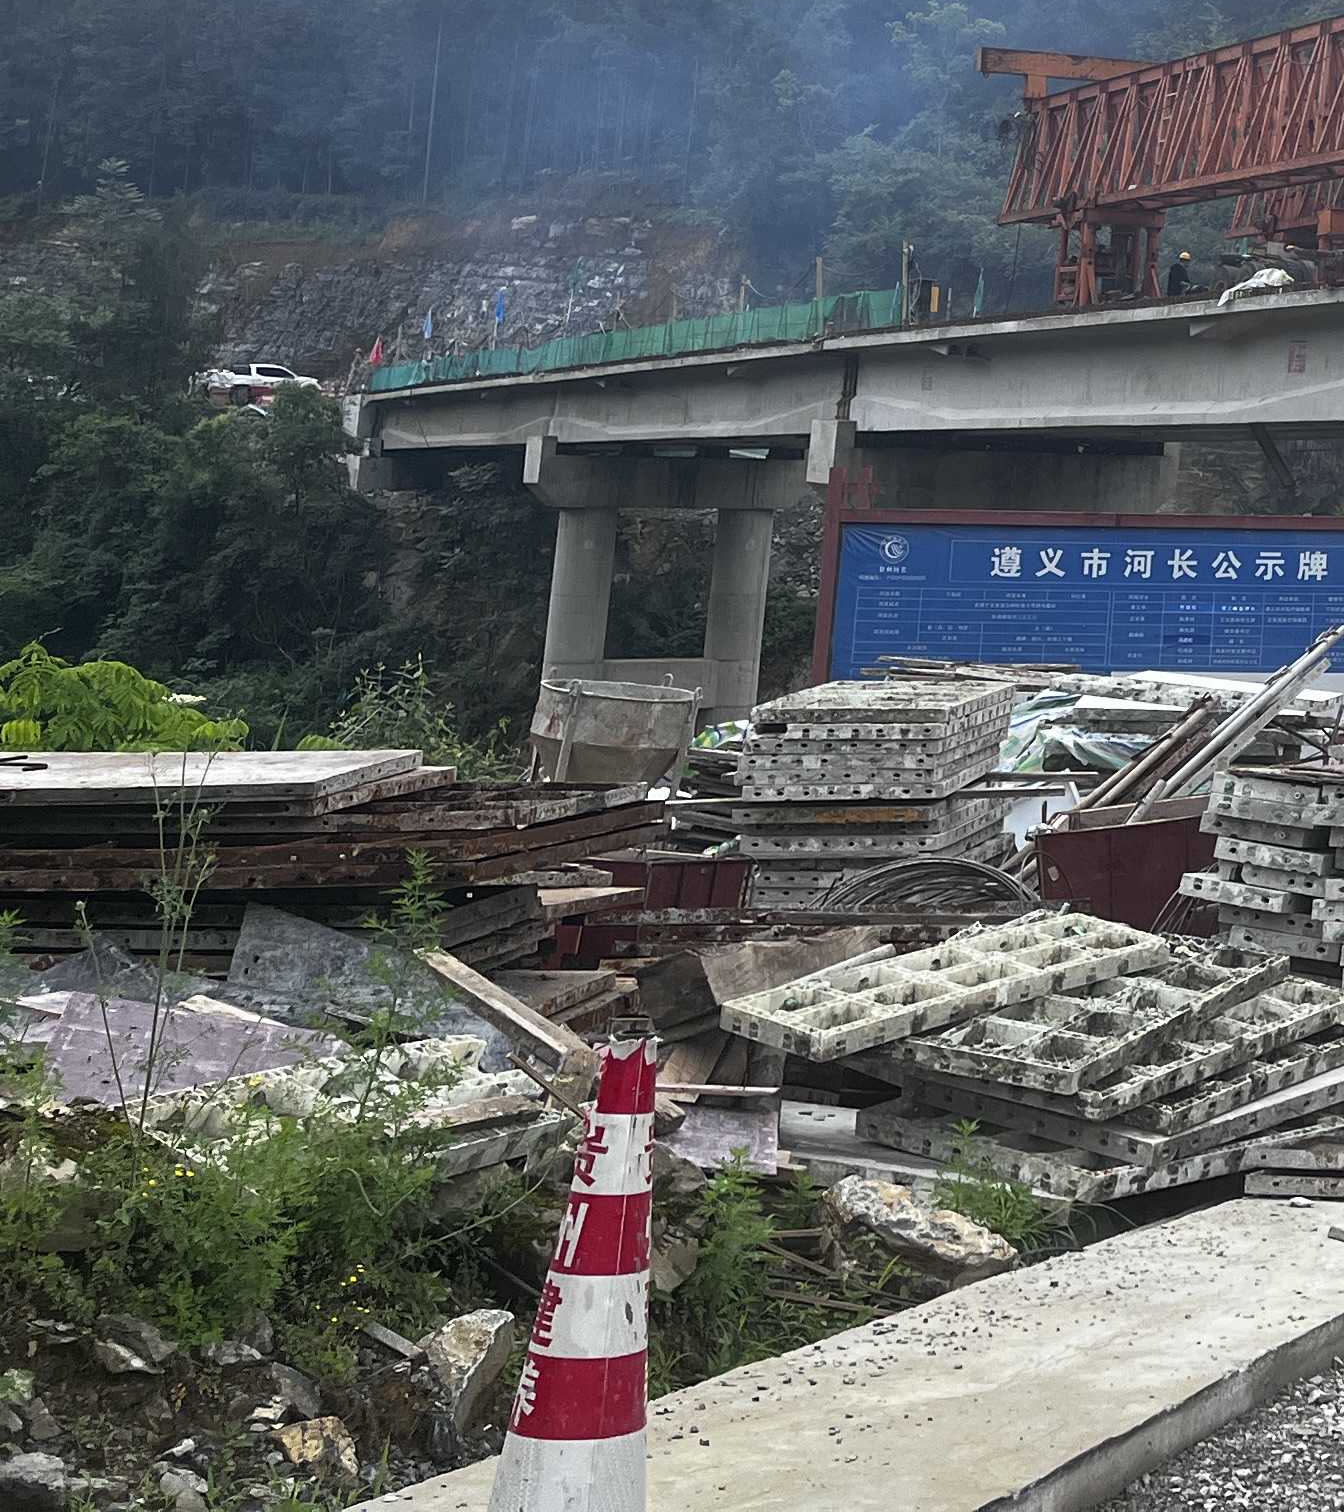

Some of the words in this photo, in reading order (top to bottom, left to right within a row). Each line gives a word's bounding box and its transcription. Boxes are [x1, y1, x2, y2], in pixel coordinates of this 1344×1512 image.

[990, 546, 1329, 581] 遵义市河长公示牌
